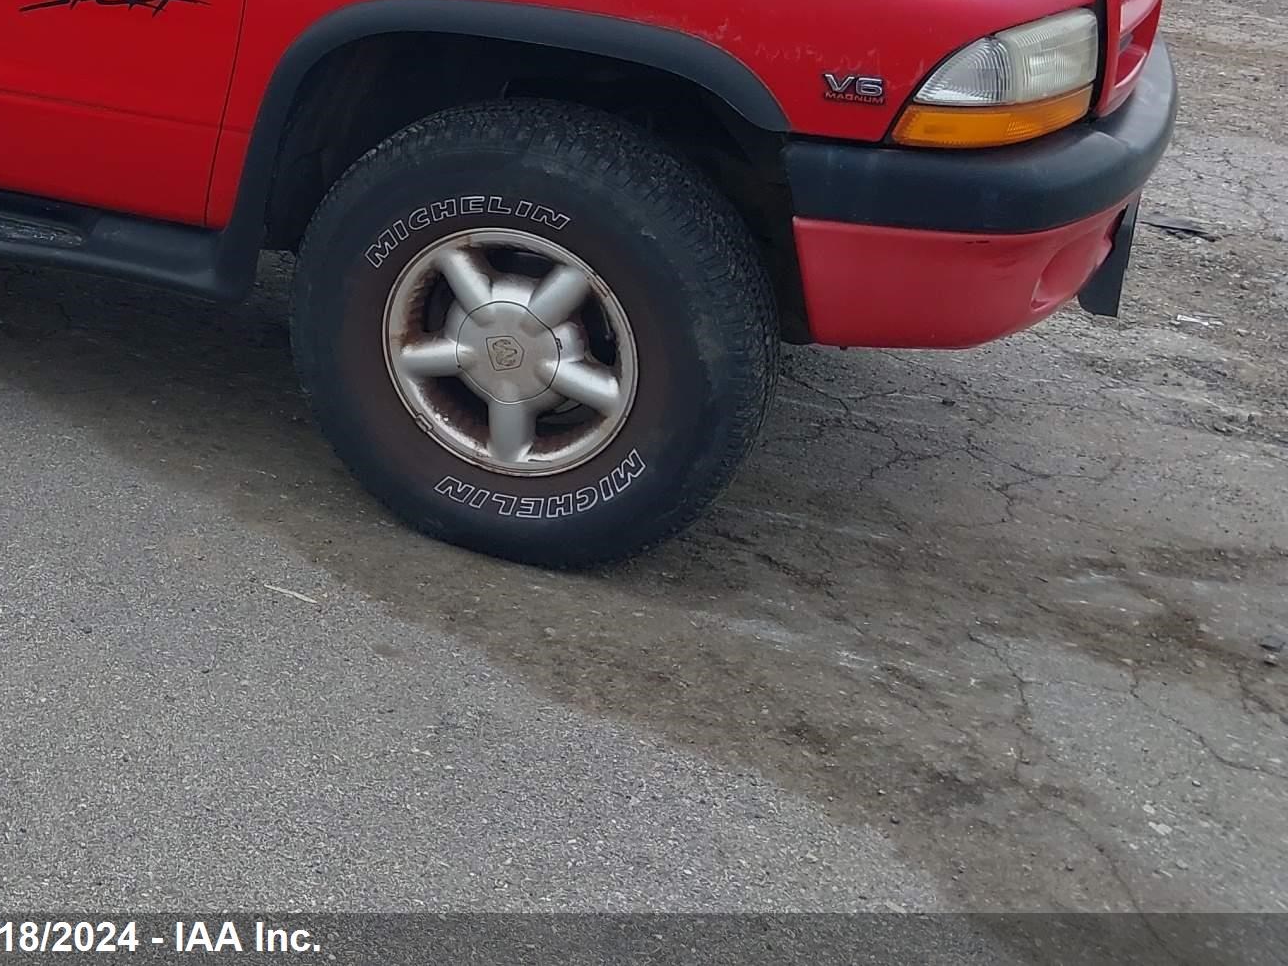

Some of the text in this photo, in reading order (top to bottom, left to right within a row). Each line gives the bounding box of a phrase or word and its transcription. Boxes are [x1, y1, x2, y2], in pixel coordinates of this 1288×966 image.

[824, 73, 883, 97] V6
[825, 92, 884, 104] MAGNUM
[364, 195, 571, 269] MICHELIN
[434, 448, 647, 519] MICHELIN
